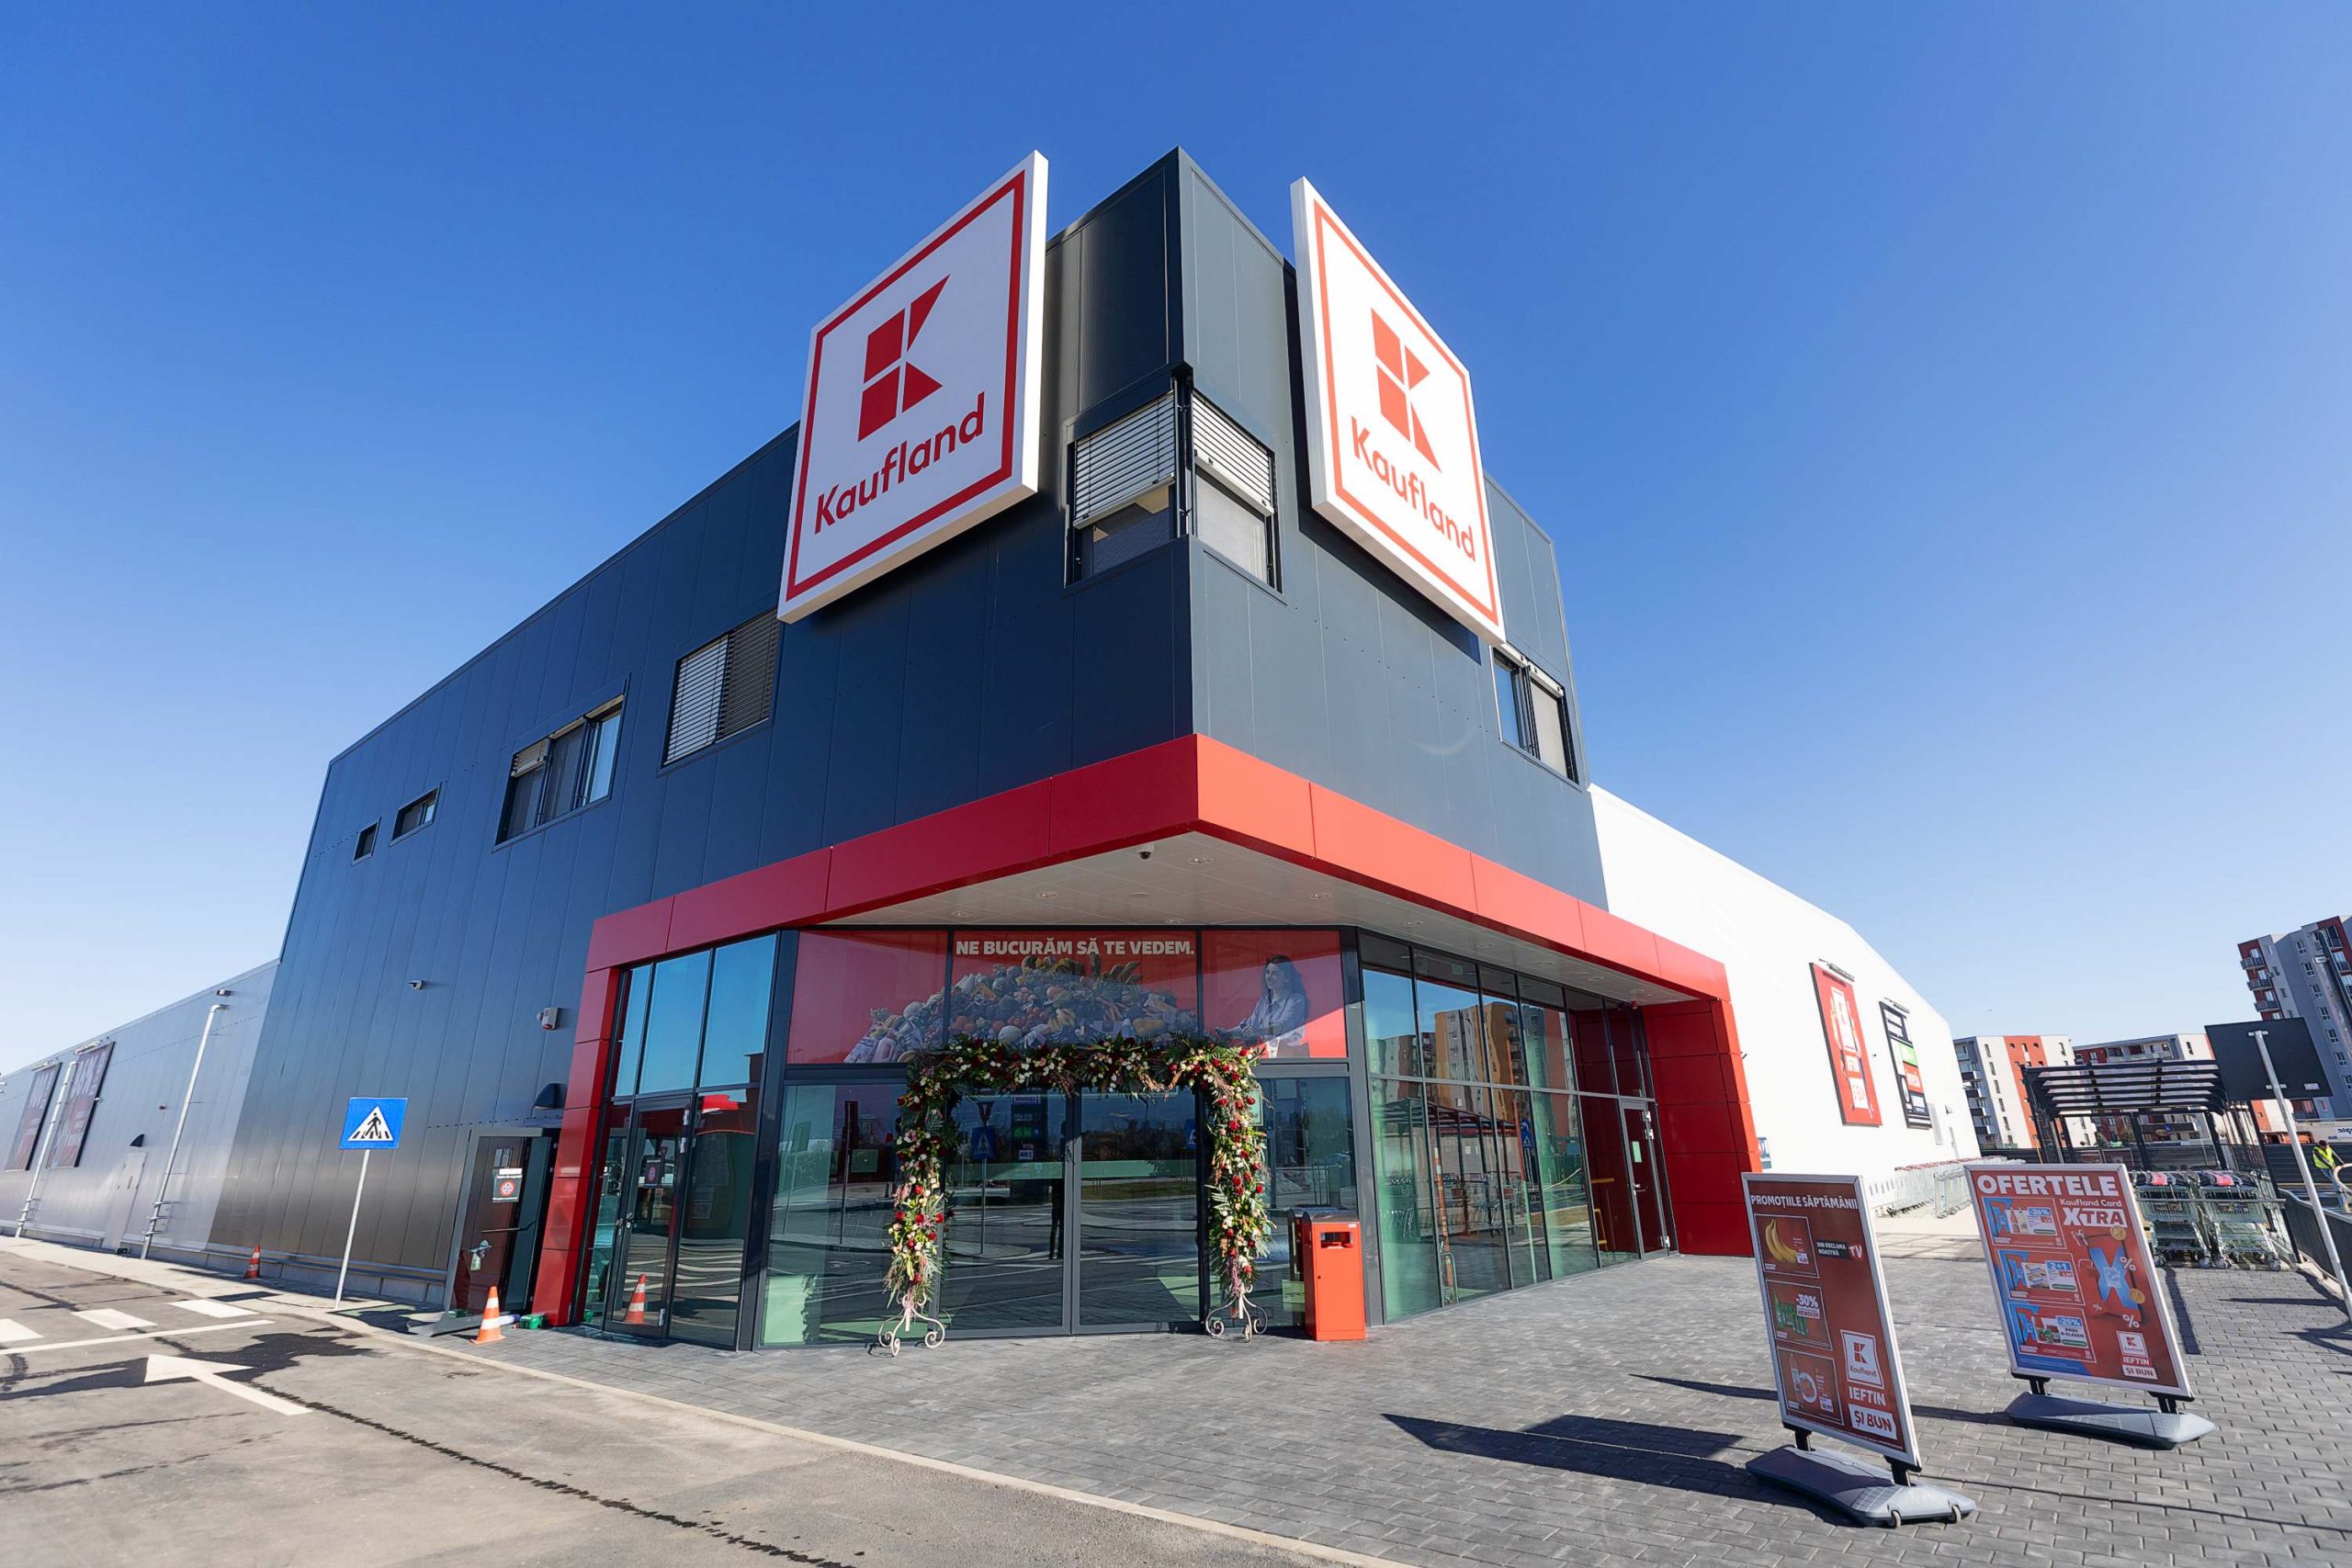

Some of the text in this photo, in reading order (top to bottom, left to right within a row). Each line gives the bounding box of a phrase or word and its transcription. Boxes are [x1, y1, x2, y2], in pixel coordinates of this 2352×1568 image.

[814, 390, 986, 536] Kaufland
[1351, 414, 1476, 563] Kaufland
[956, 937, 1195, 955] NE BUCURĂM SĂ TE VEDEM.
[1976, 1174, 2120, 1197] OFERTELE
[1750, 1194, 1803, 1209] PROMOȚIILE
[2060, 1198, 2122, 1207] Kaufland Card
[2063, 1207, 2125, 1227] XTRA
[1849, 1245, 1863, 1258] TV
[2050, 1262, 2067, 1270] 2+1
[1795, 1293, 1819, 1308] -30%
[1849, 1364, 1877, 1378] Kaufland
[1849, 1385, 1886, 1406] IEFTIN
[1854, 1409, 1893, 1432] ȘI BUN
